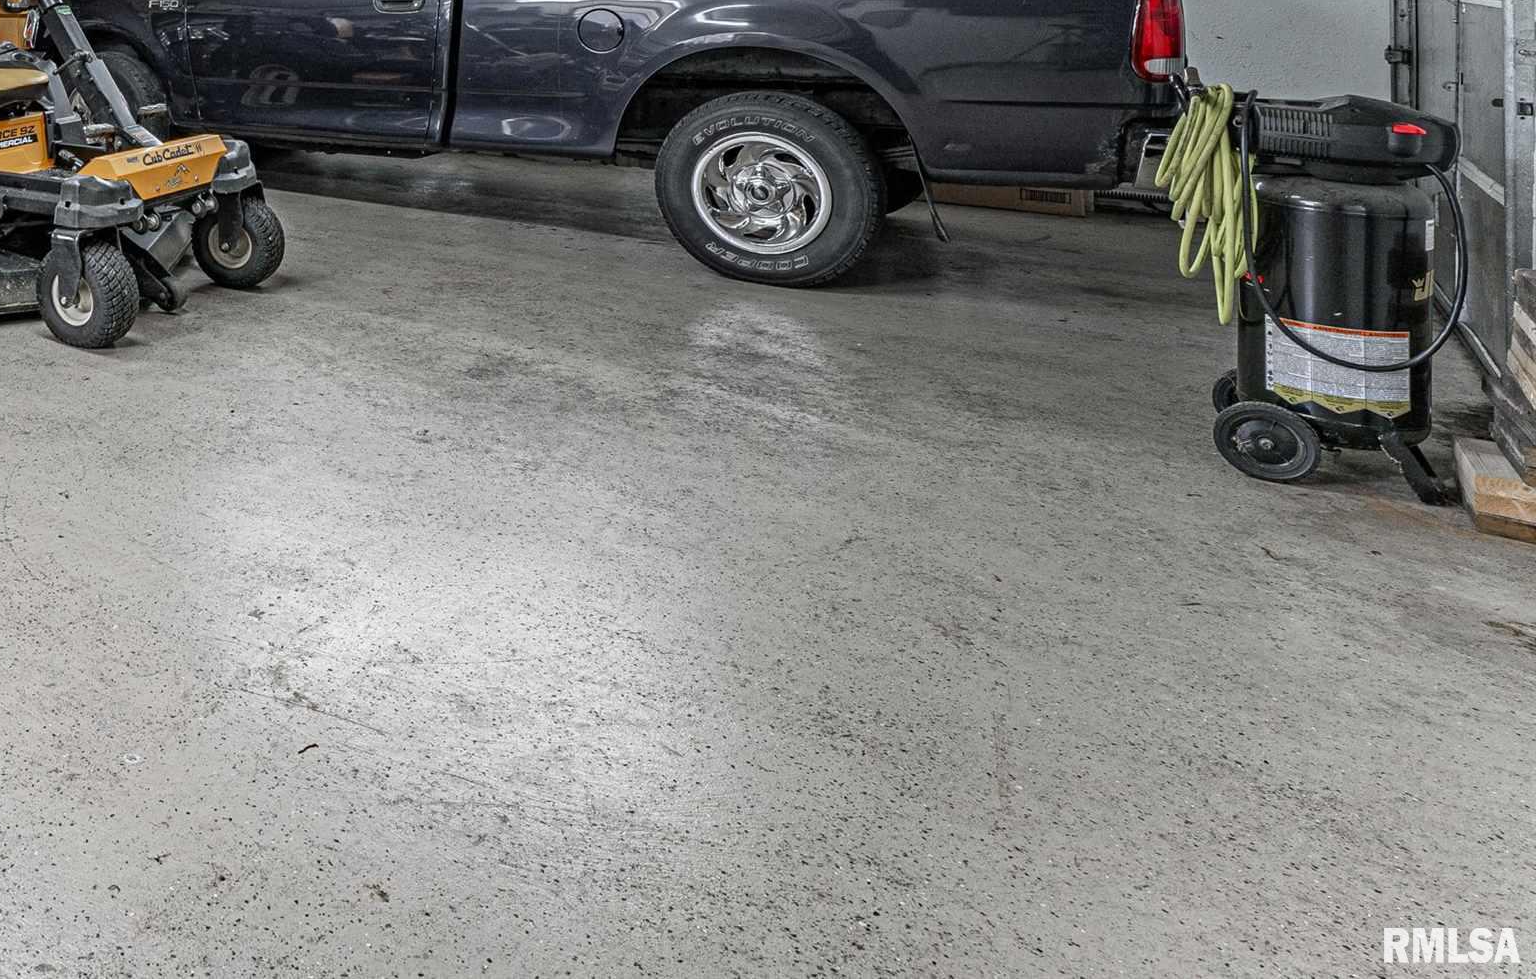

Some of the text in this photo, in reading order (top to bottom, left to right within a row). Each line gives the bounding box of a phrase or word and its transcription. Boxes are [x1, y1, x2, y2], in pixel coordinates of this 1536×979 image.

[148, 0, 180, 9] F150
[692, 116, 815, 146] EVOLUTION
[142, 143, 195, 166] Cub Cadet
[705, 241, 809, 271] COOPER
